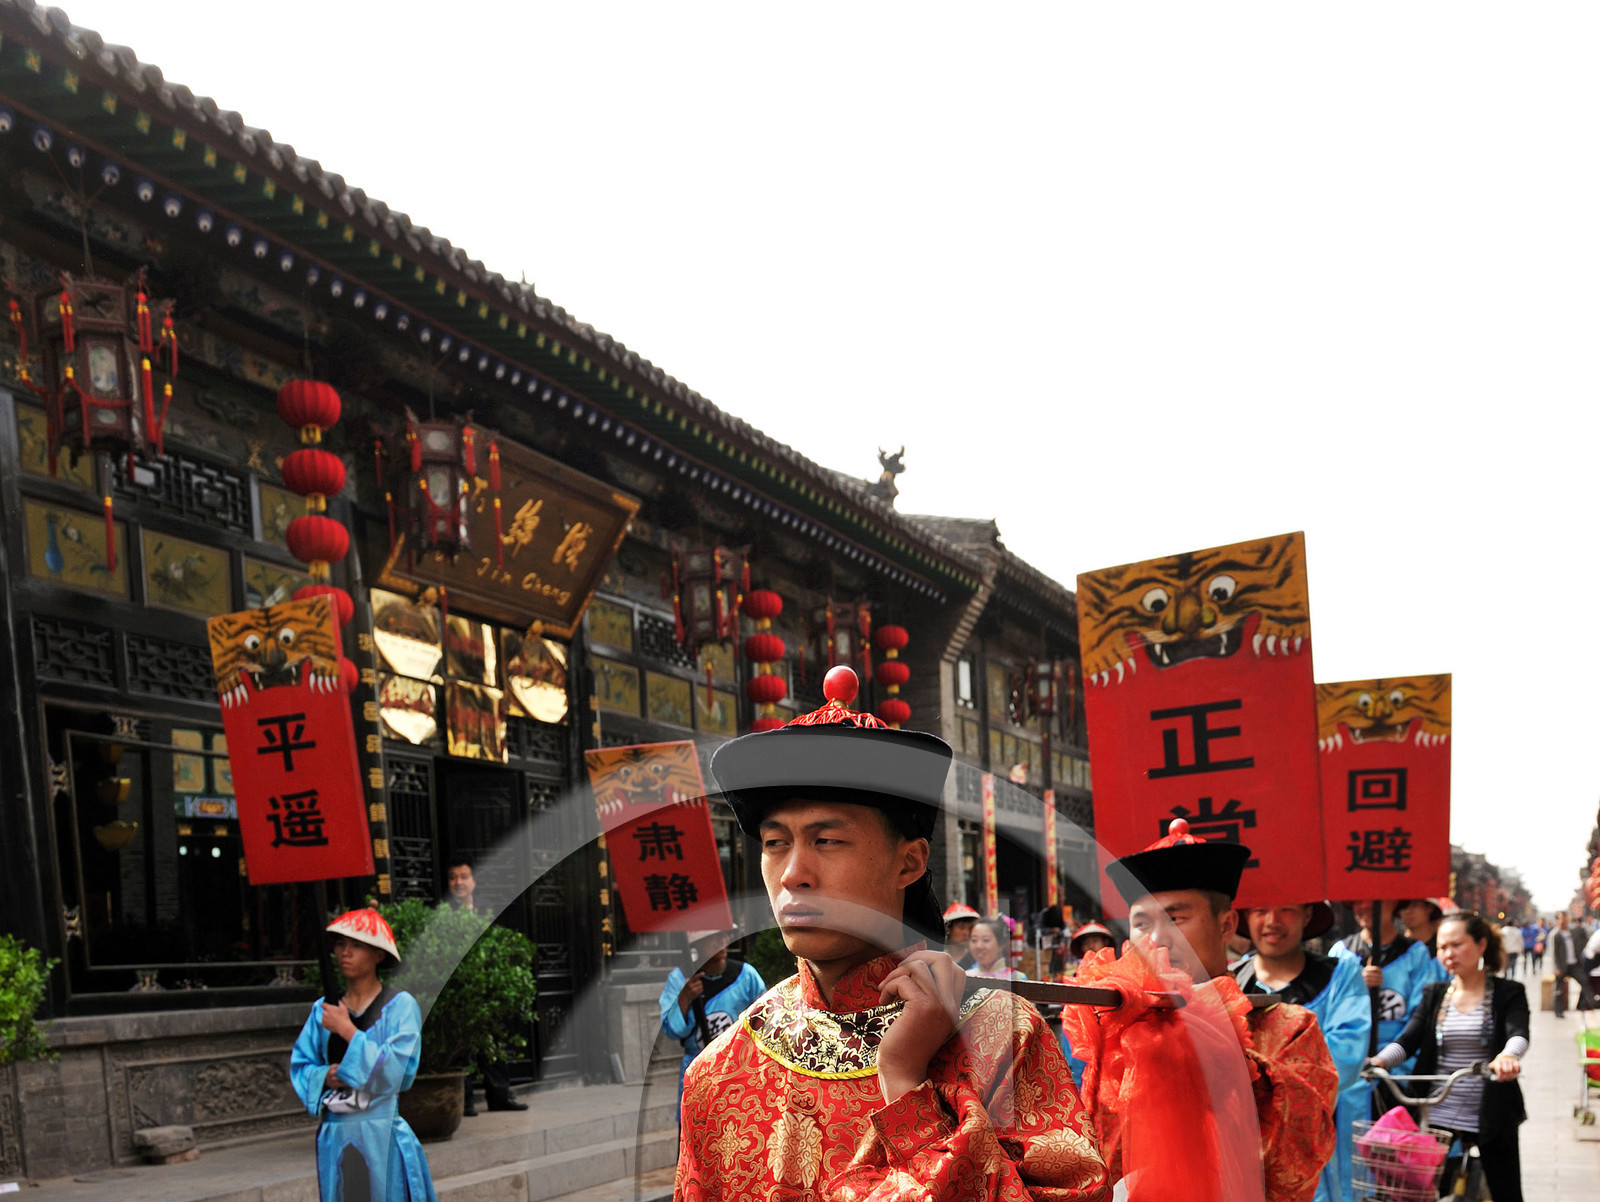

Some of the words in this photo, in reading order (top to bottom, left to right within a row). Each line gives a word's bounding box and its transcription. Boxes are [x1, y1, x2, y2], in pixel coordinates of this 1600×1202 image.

[520, 571, 572, 607] Cheng
[256, 711, 330, 849] 平遥
[1346, 767, 1413, 874] 回避
[632, 821, 699, 913] 肃静
